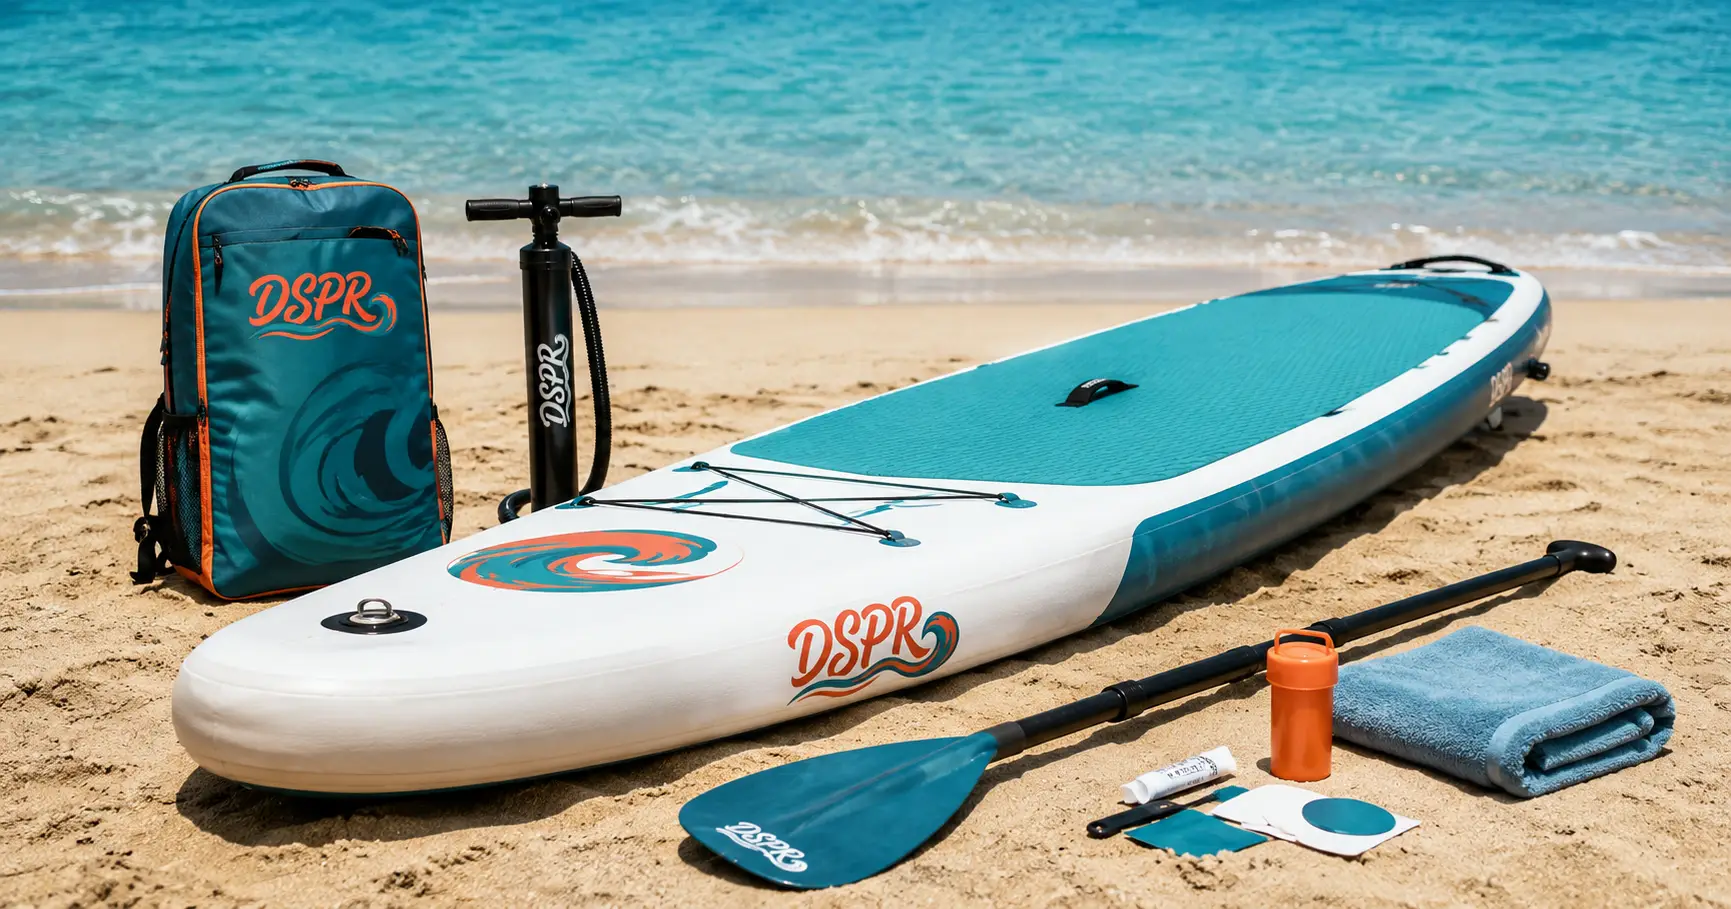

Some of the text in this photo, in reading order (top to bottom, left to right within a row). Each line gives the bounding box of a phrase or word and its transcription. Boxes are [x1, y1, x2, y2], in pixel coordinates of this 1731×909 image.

[248, 270, 378, 327] DSPR
[536, 342, 568, 428] DSPR
[786, 595, 932, 688] DSPR
[722, 821, 808, 872] DSPR
